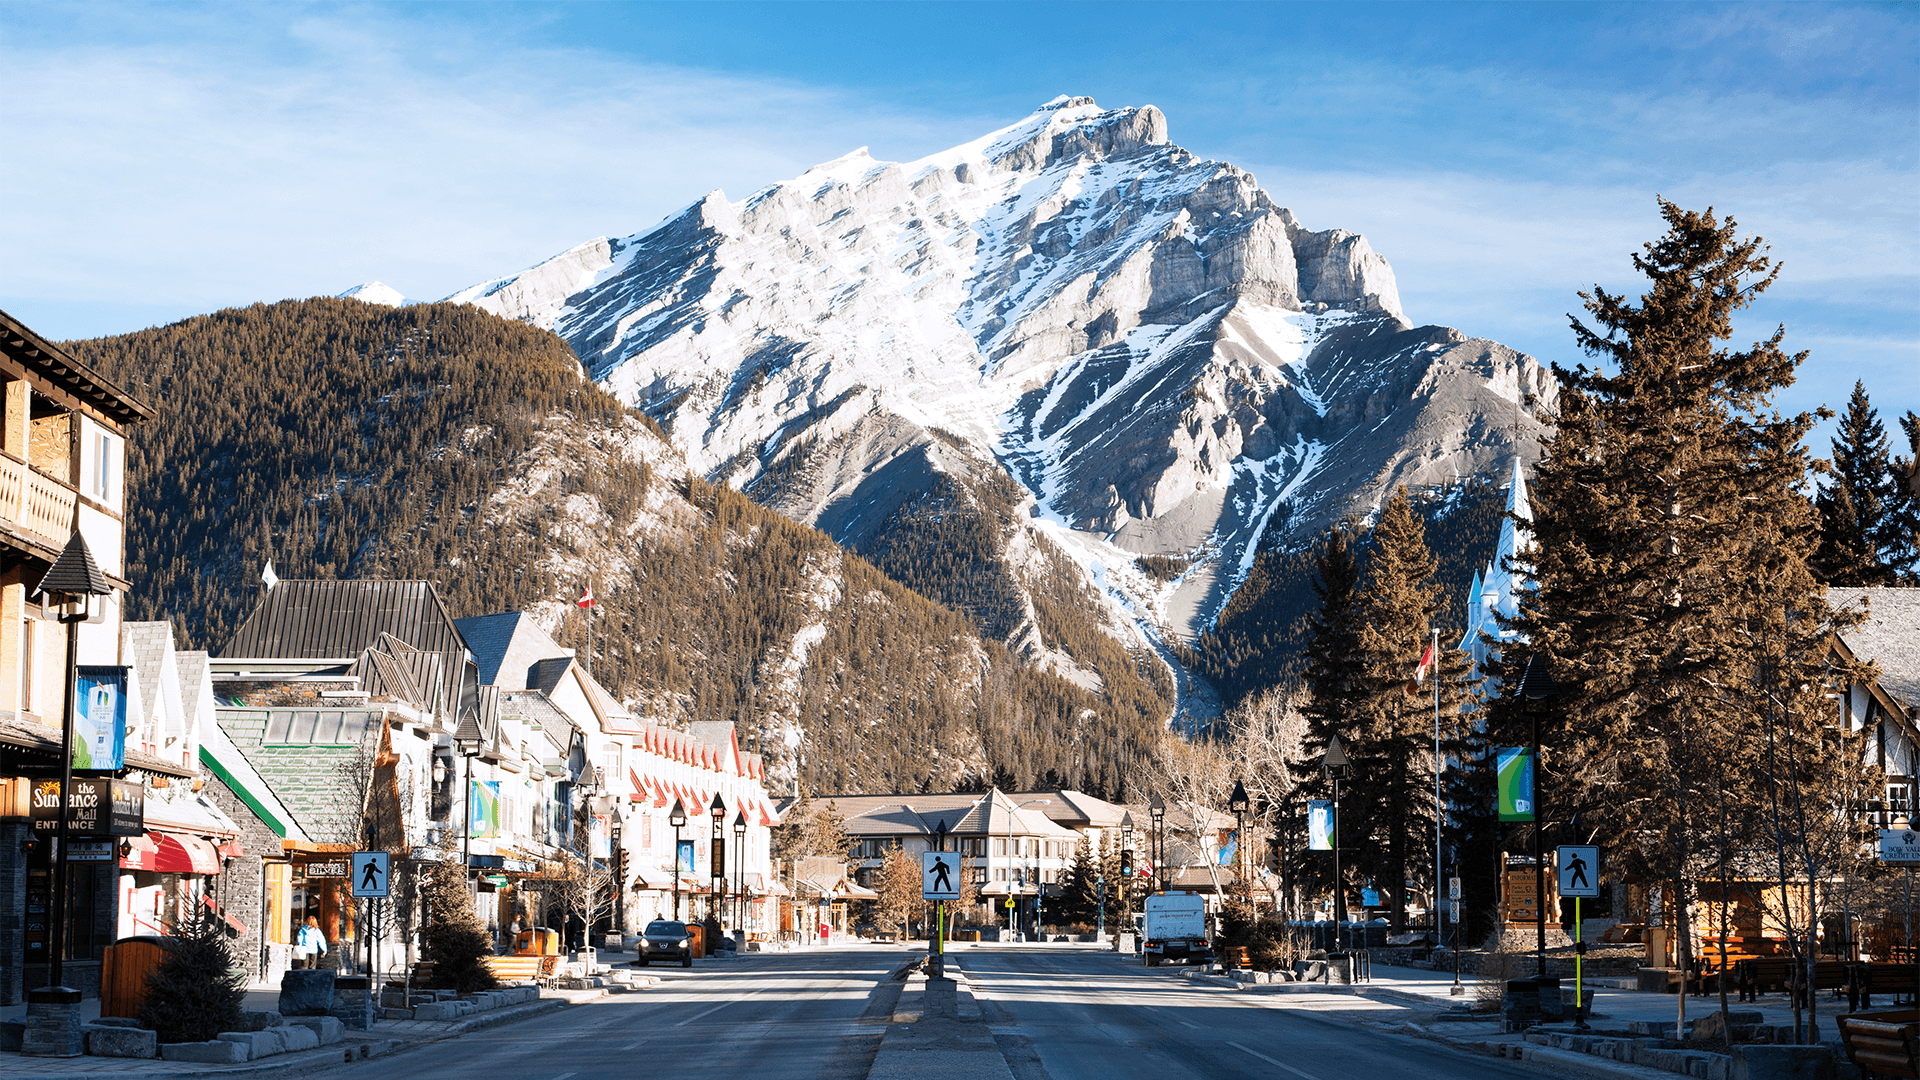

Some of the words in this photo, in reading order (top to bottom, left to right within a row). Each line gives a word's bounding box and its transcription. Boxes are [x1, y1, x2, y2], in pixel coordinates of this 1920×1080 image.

[77, 782, 96, 794] the
[33, 788, 99, 808] Sunance
[75, 808, 98, 820] Mall
[35, 820, 95, 830] ENTNCE
